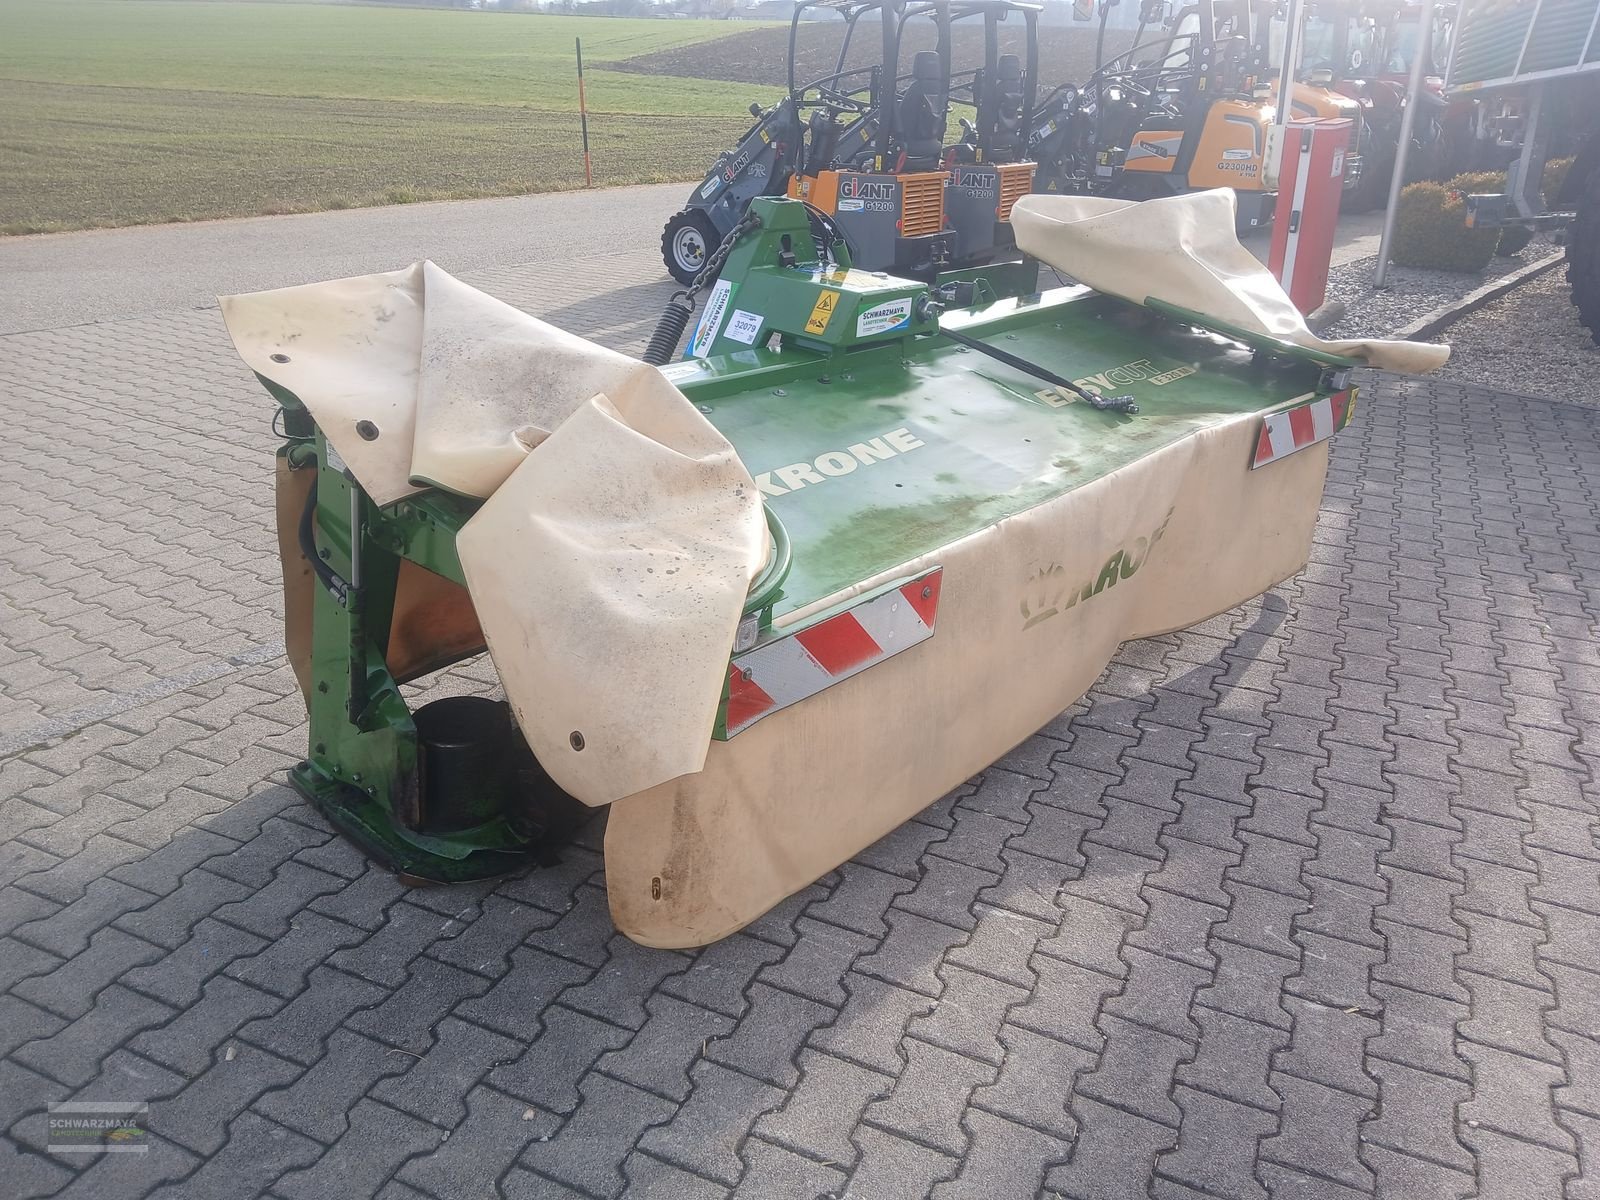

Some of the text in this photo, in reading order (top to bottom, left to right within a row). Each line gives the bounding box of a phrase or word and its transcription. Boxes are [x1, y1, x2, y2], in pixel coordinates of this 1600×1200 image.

[1217, 162, 1258, 171] G2300HD
[965, 189, 994, 199] G1200
[865, 200, 895, 211] G1200
[701, 288, 730, 347] SCHWARZMAYR
[863, 307, 904, 320] SCHWARZMAYR
[735, 320, 757, 333] 32079
[754, 427, 926, 500] KRONE
